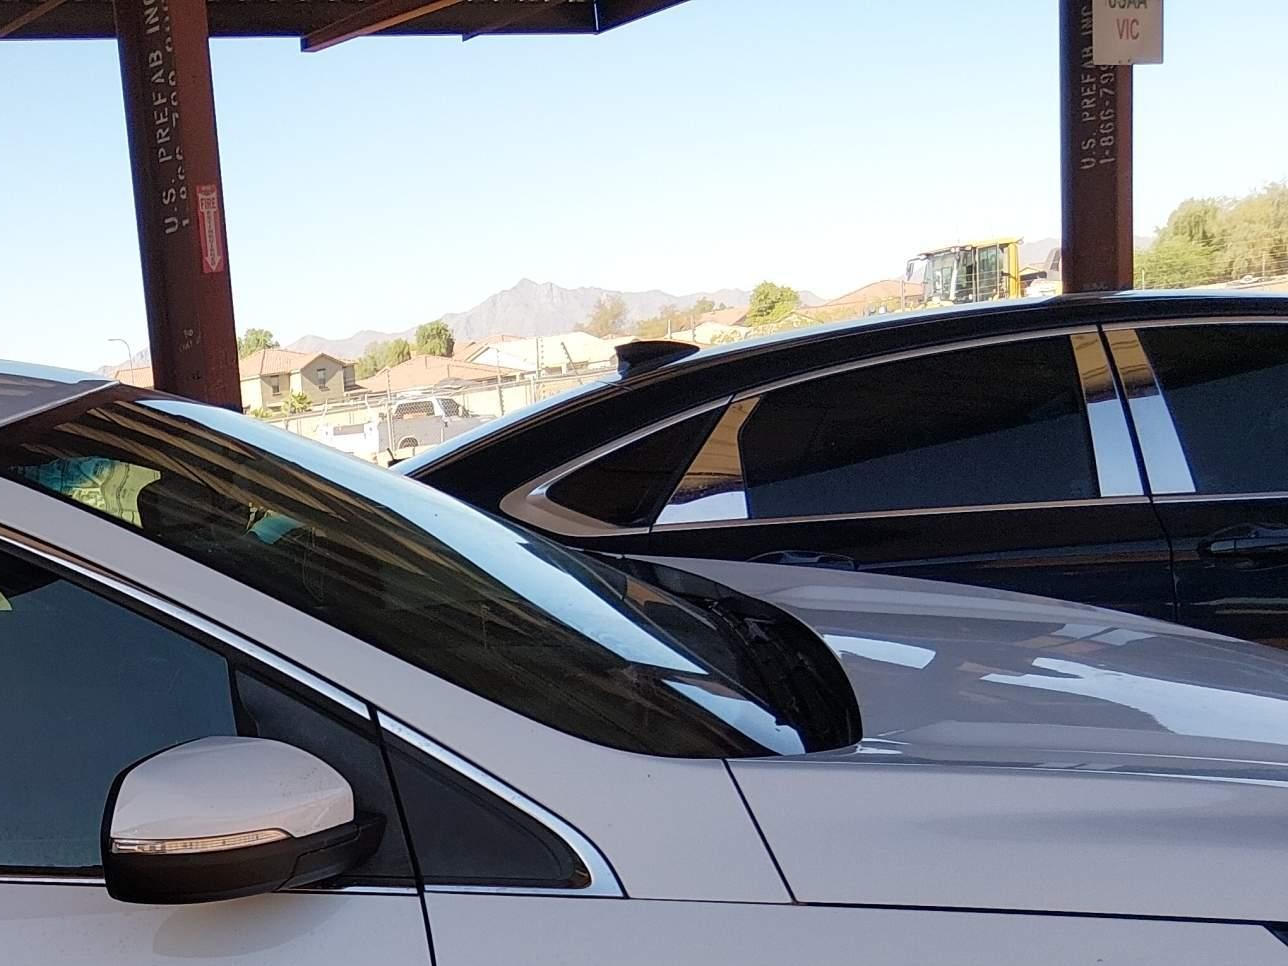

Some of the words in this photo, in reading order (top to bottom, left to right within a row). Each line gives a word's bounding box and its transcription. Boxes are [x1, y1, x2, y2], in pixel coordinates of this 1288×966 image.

[1116, 18, 1140, 40] VIC
[148, 50, 173, 163] PREFAB
[1080, 129, 1098, 170] U.S.
[163, 179, 179, 234] U.S.
